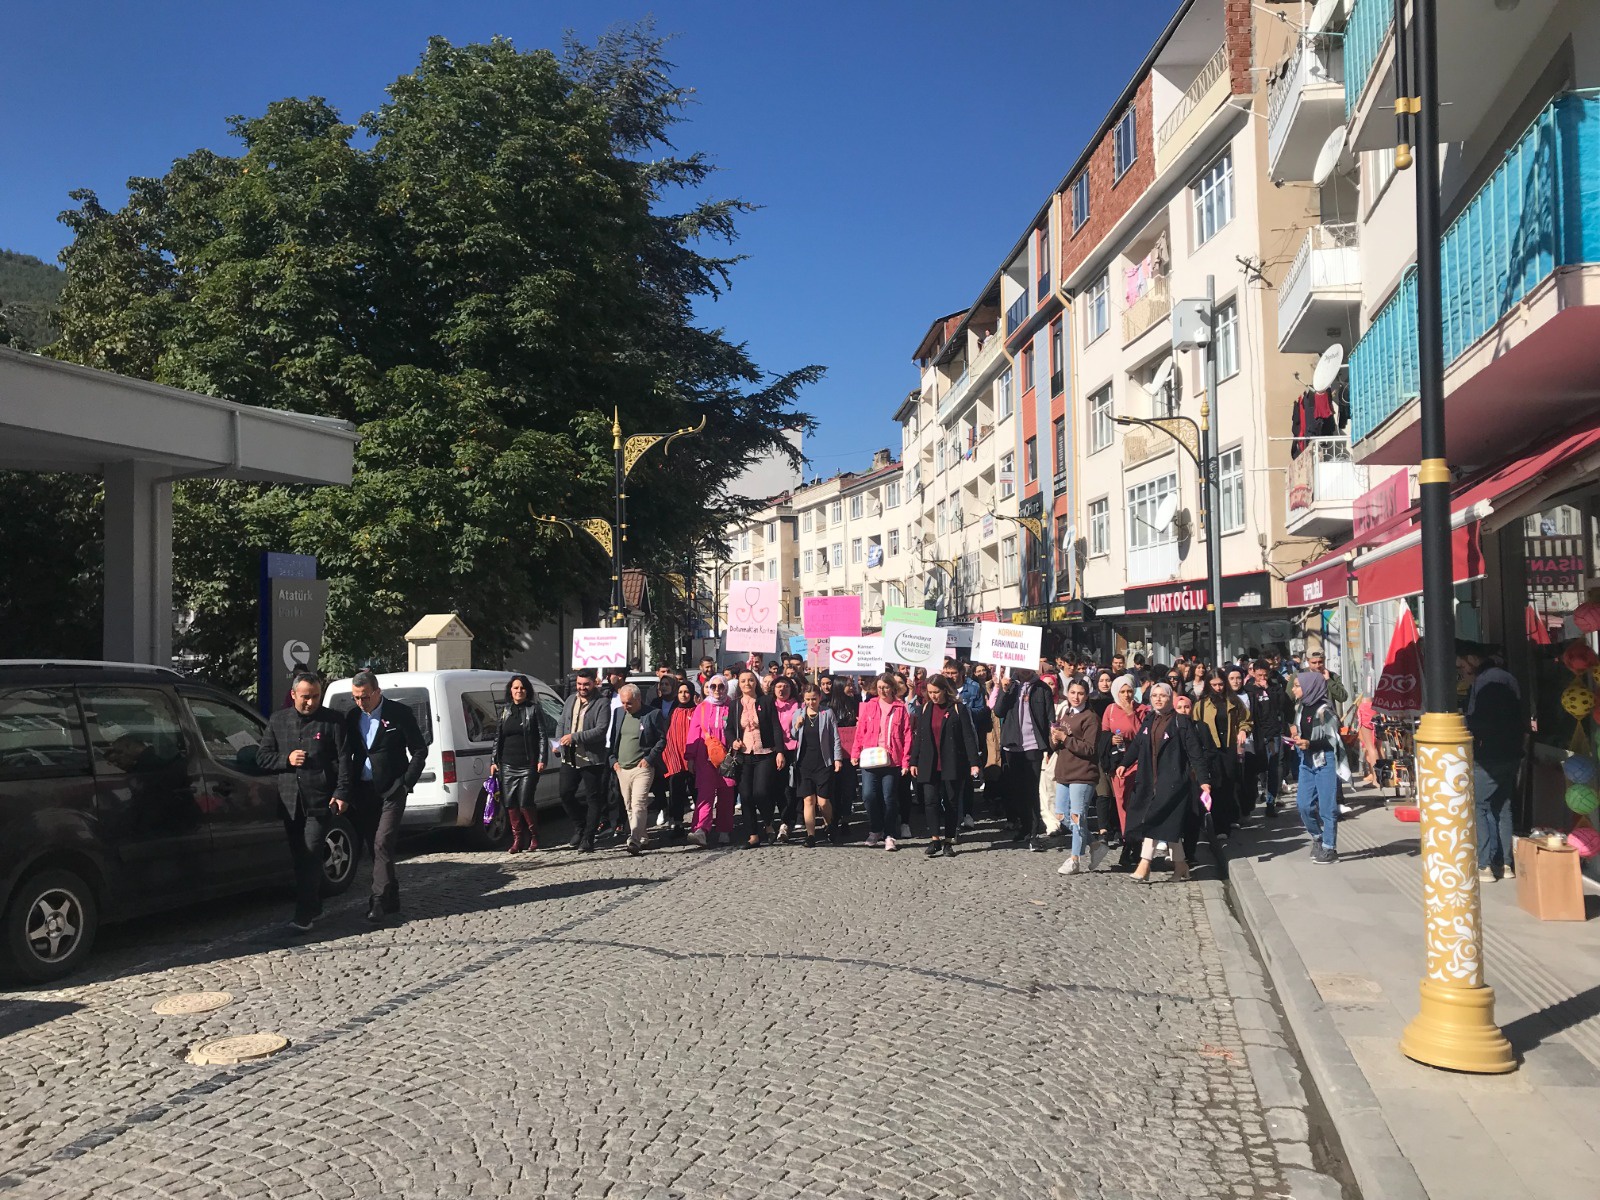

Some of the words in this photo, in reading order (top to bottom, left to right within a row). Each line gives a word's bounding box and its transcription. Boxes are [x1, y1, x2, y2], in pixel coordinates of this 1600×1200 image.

[279, 589, 313, 601] Atatürk
[1147, 586, 1204, 613] KURTOĞLU
[998, 628, 1024, 638] KORKMA!
[991, 639, 1019, 649] FARKINDA
[1004, 651, 1026, 661] KALMA!
